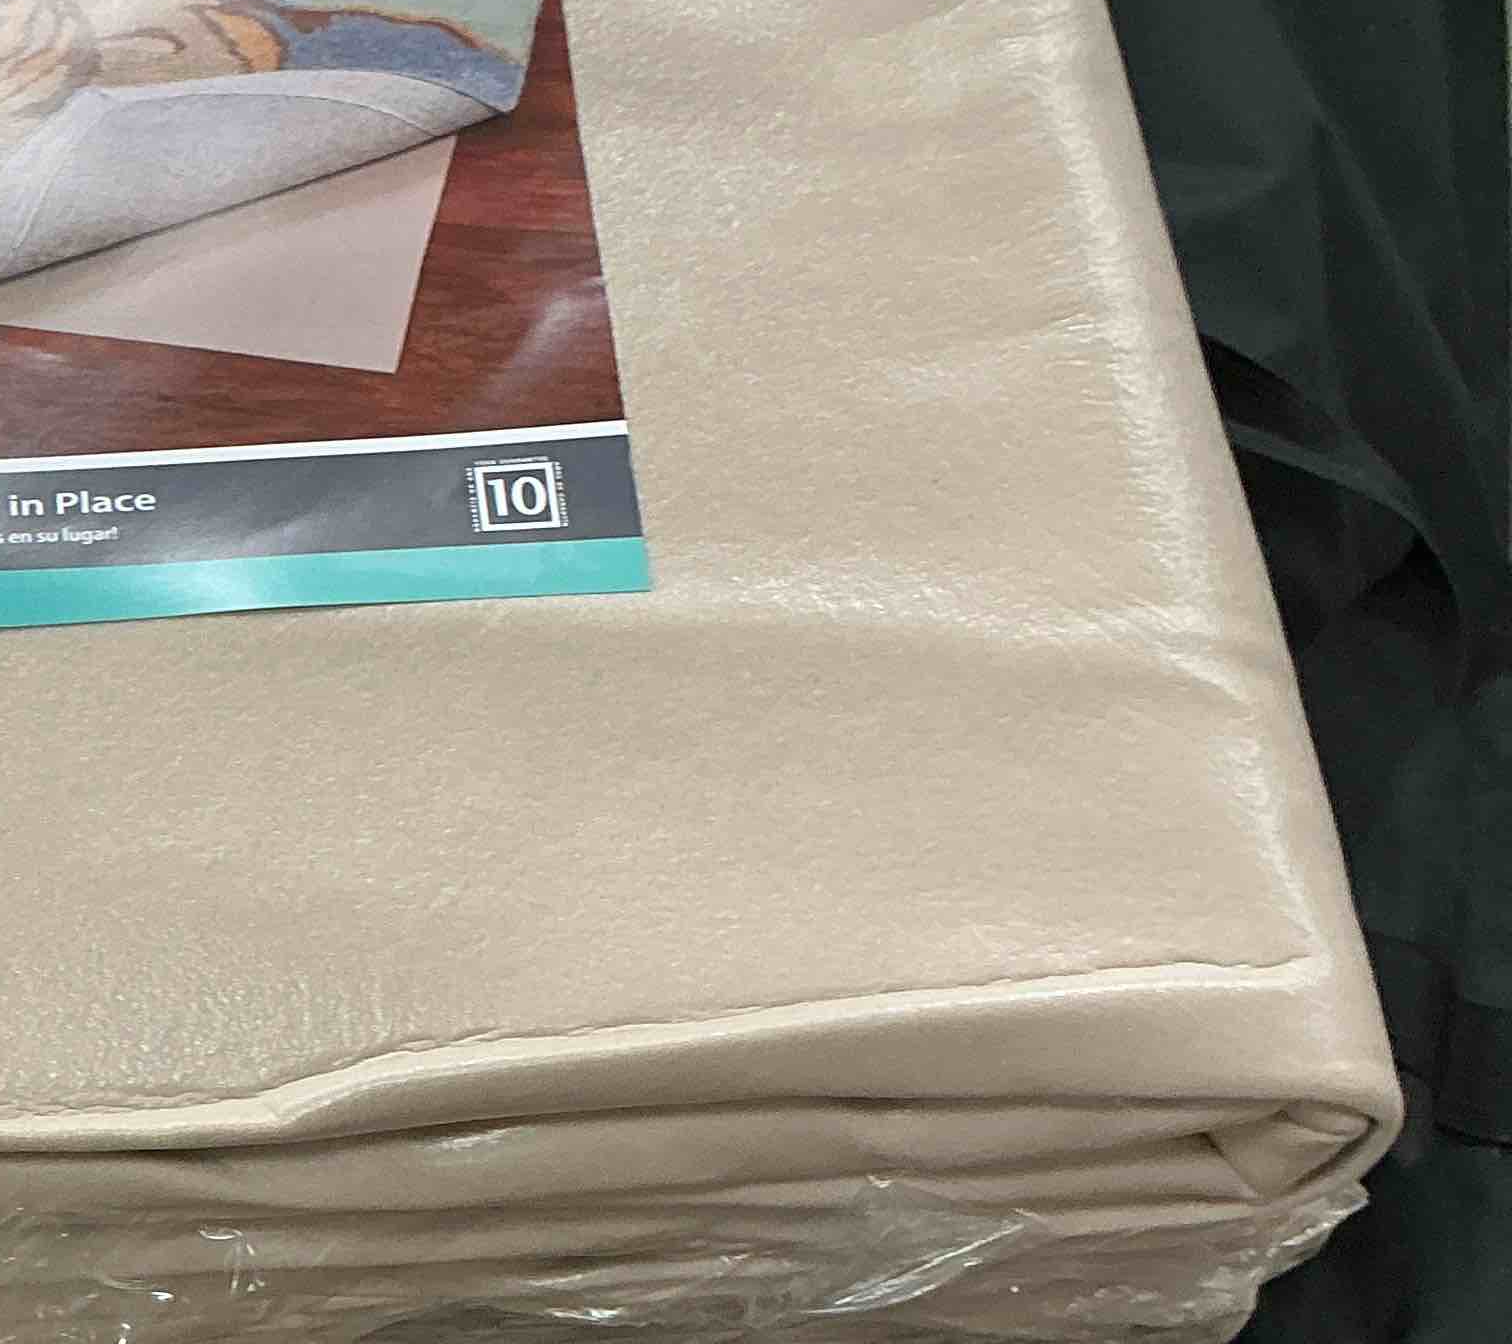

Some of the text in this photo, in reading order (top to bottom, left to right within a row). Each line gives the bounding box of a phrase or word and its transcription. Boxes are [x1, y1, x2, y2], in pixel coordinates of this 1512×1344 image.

[8, 494, 45, 518] in
[55, 490, 157, 516] Place
[487, 475, 548, 517] 10
[7, 531, 33, 544] en
[37, 531, 60, 544] su
[62, 526, 119, 545] lugar!
